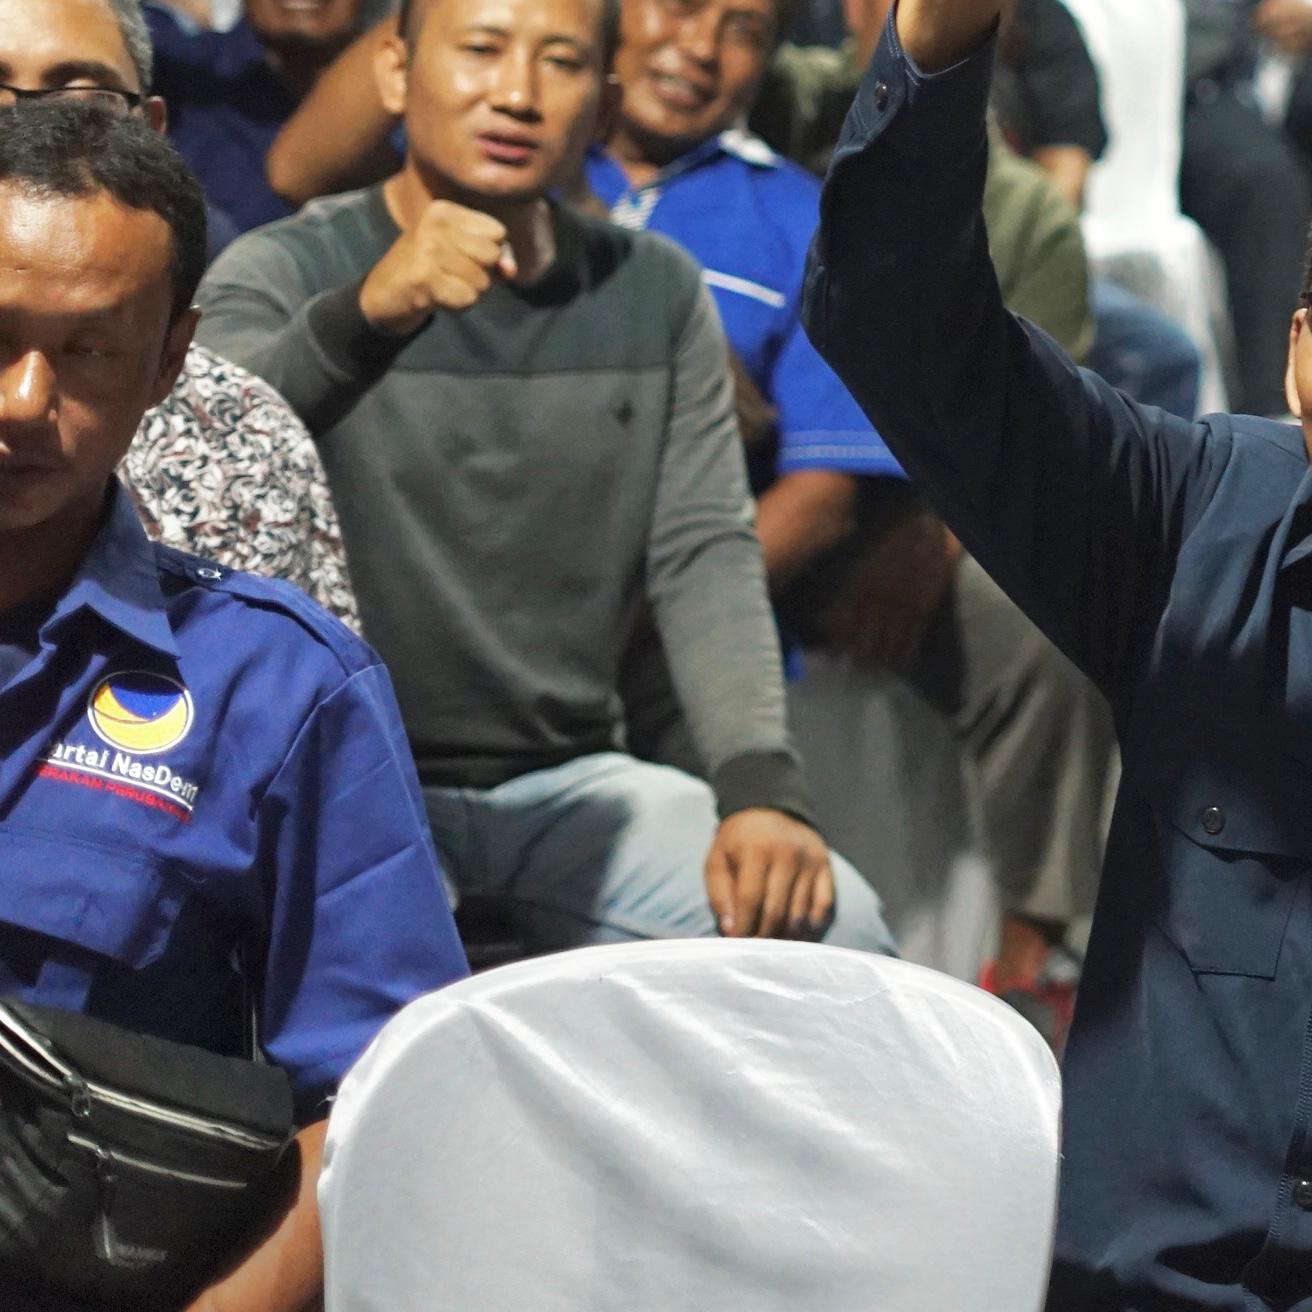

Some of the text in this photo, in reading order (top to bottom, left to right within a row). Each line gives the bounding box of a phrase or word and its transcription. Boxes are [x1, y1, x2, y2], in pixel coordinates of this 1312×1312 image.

[38, 764, 103, 790] ERAKAN
[52, 742, 199, 803] artai NasDem
